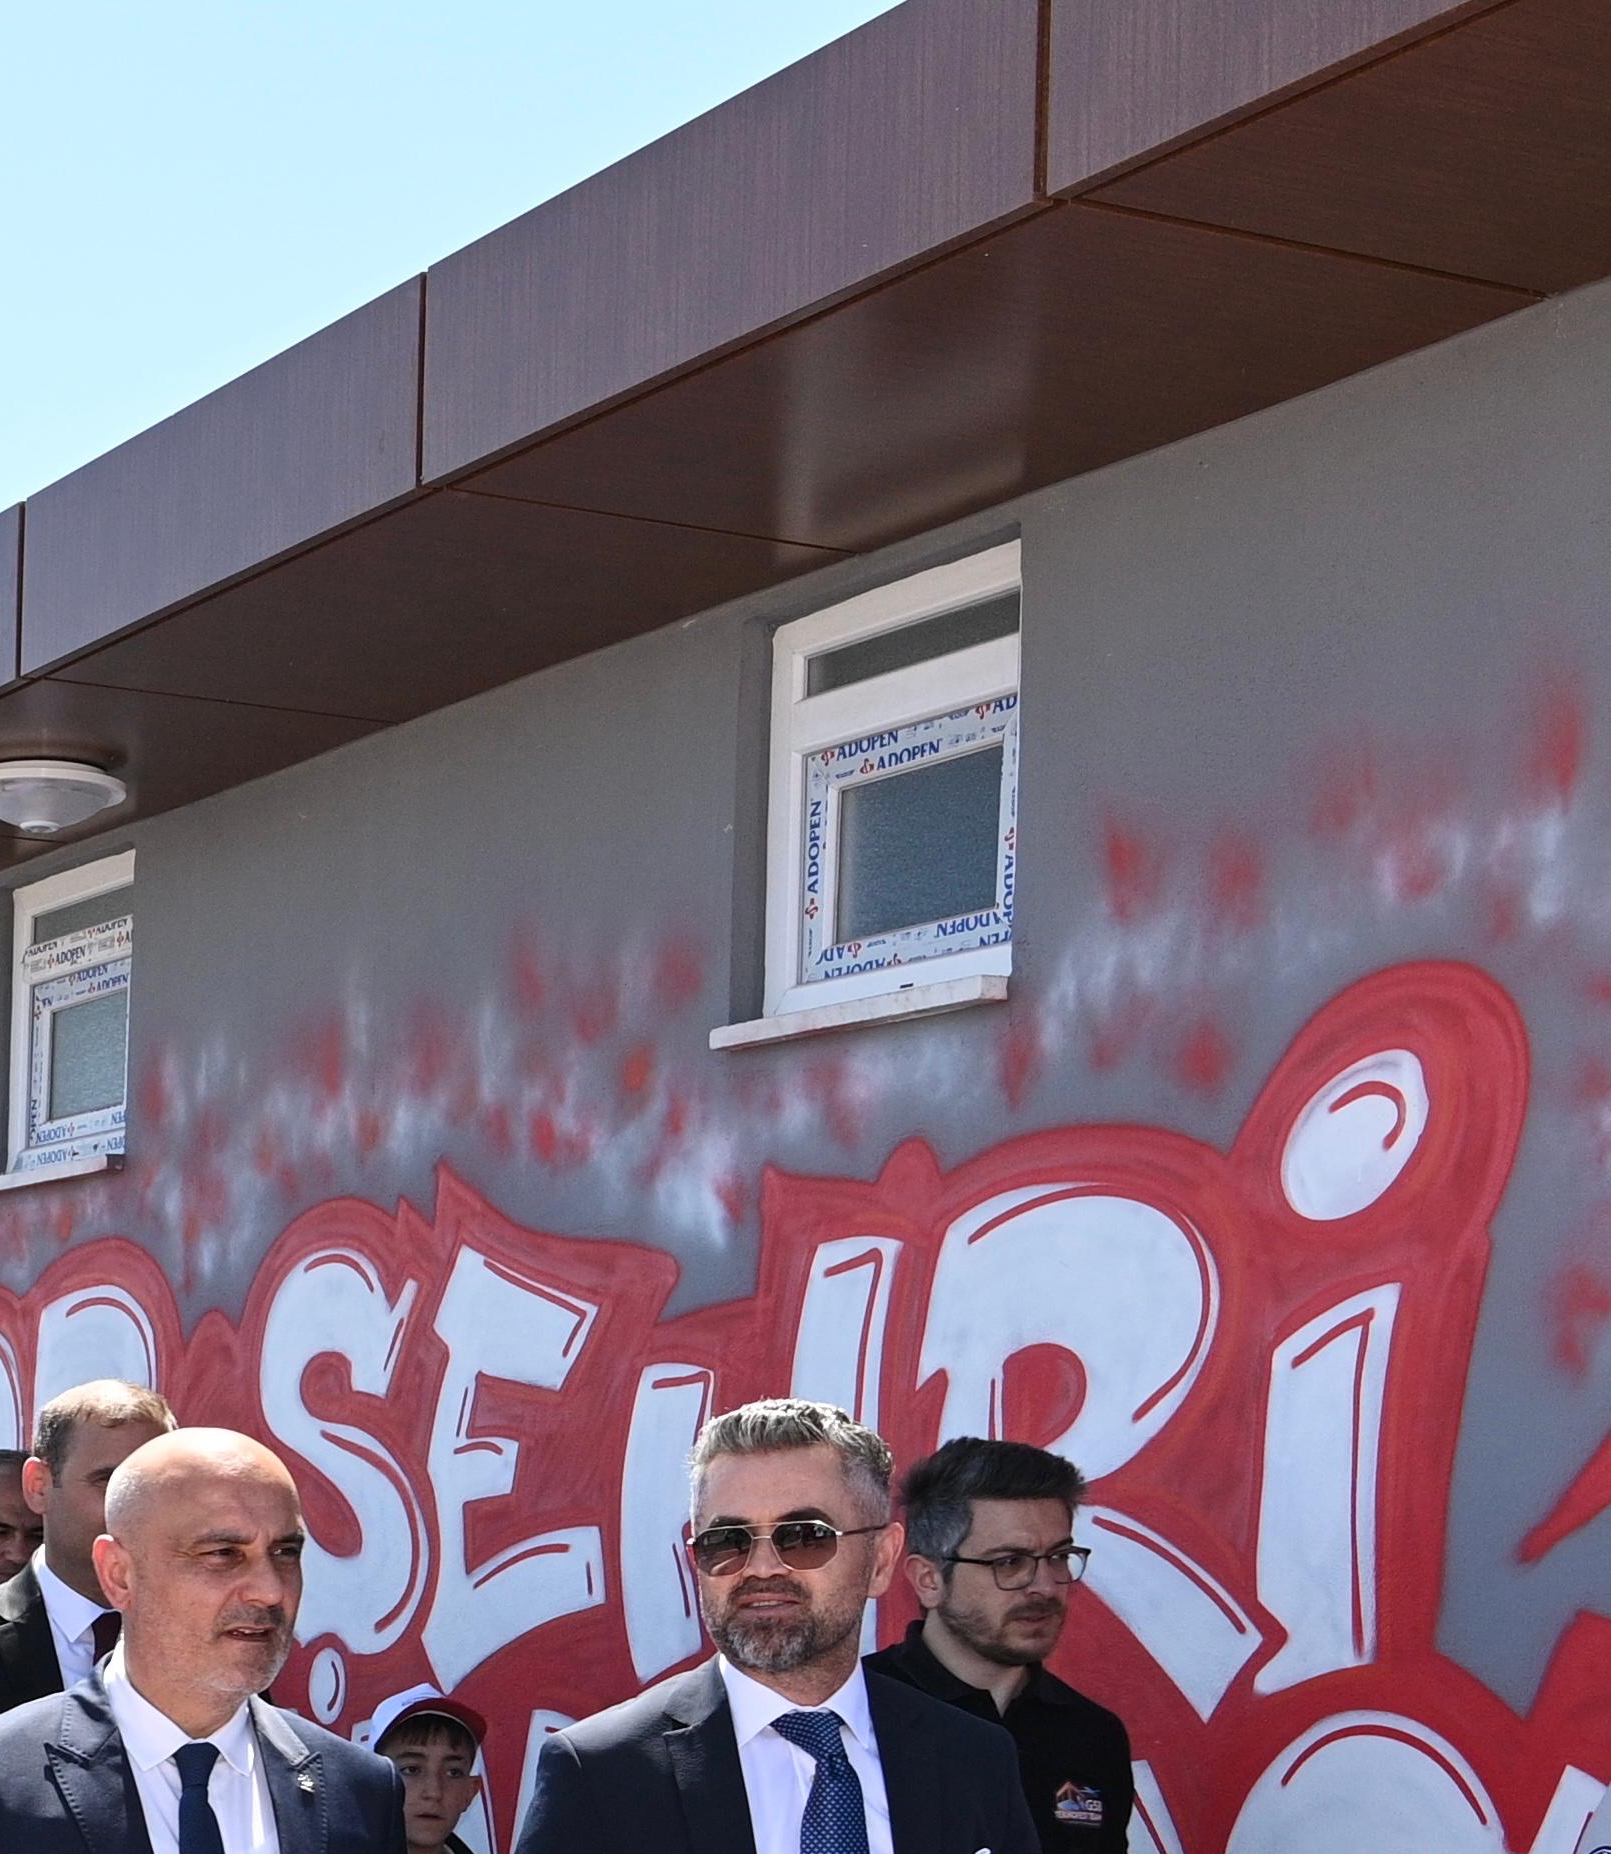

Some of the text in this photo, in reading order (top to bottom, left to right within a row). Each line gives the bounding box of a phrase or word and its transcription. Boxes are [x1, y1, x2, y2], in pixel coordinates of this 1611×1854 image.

[836, 729, 899, 762] ADOPEN
[876, 739, 941, 771] ADOPEN
[807, 800, 822, 894] ADOPEN
